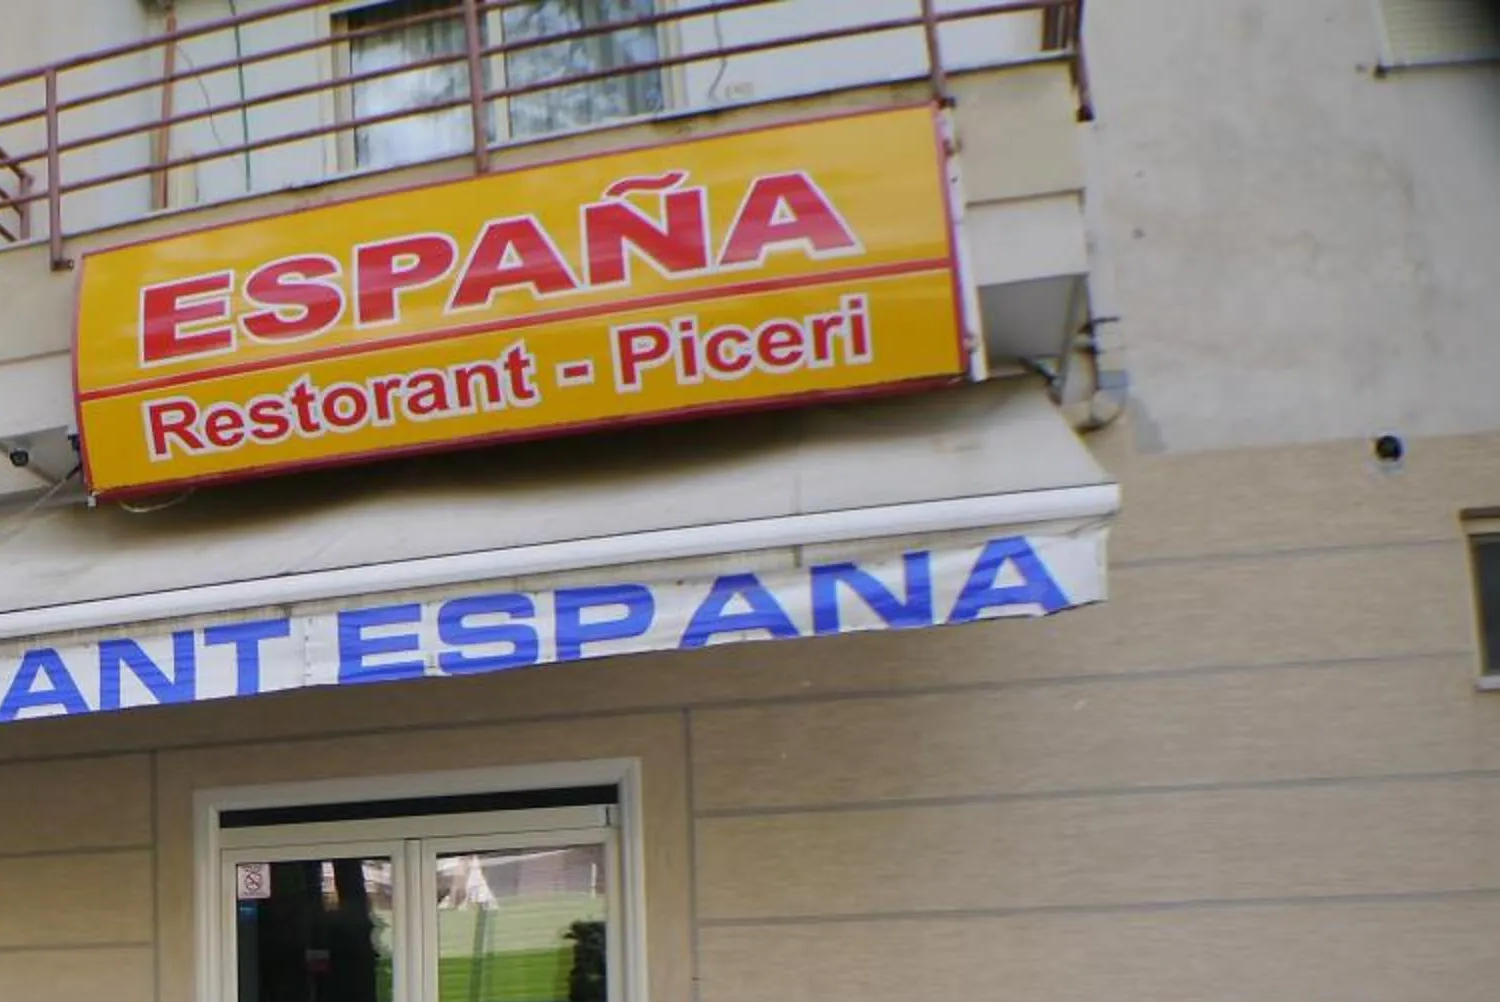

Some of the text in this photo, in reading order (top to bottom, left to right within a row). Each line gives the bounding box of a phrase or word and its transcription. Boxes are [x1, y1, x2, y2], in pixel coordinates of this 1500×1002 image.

[142, 172, 859, 363] ESPAÑA
[148, 349, 536, 456] Restorant
[616, 299, 868, 386] Piceri
[337, 535, 1071, 687] ESPANA
